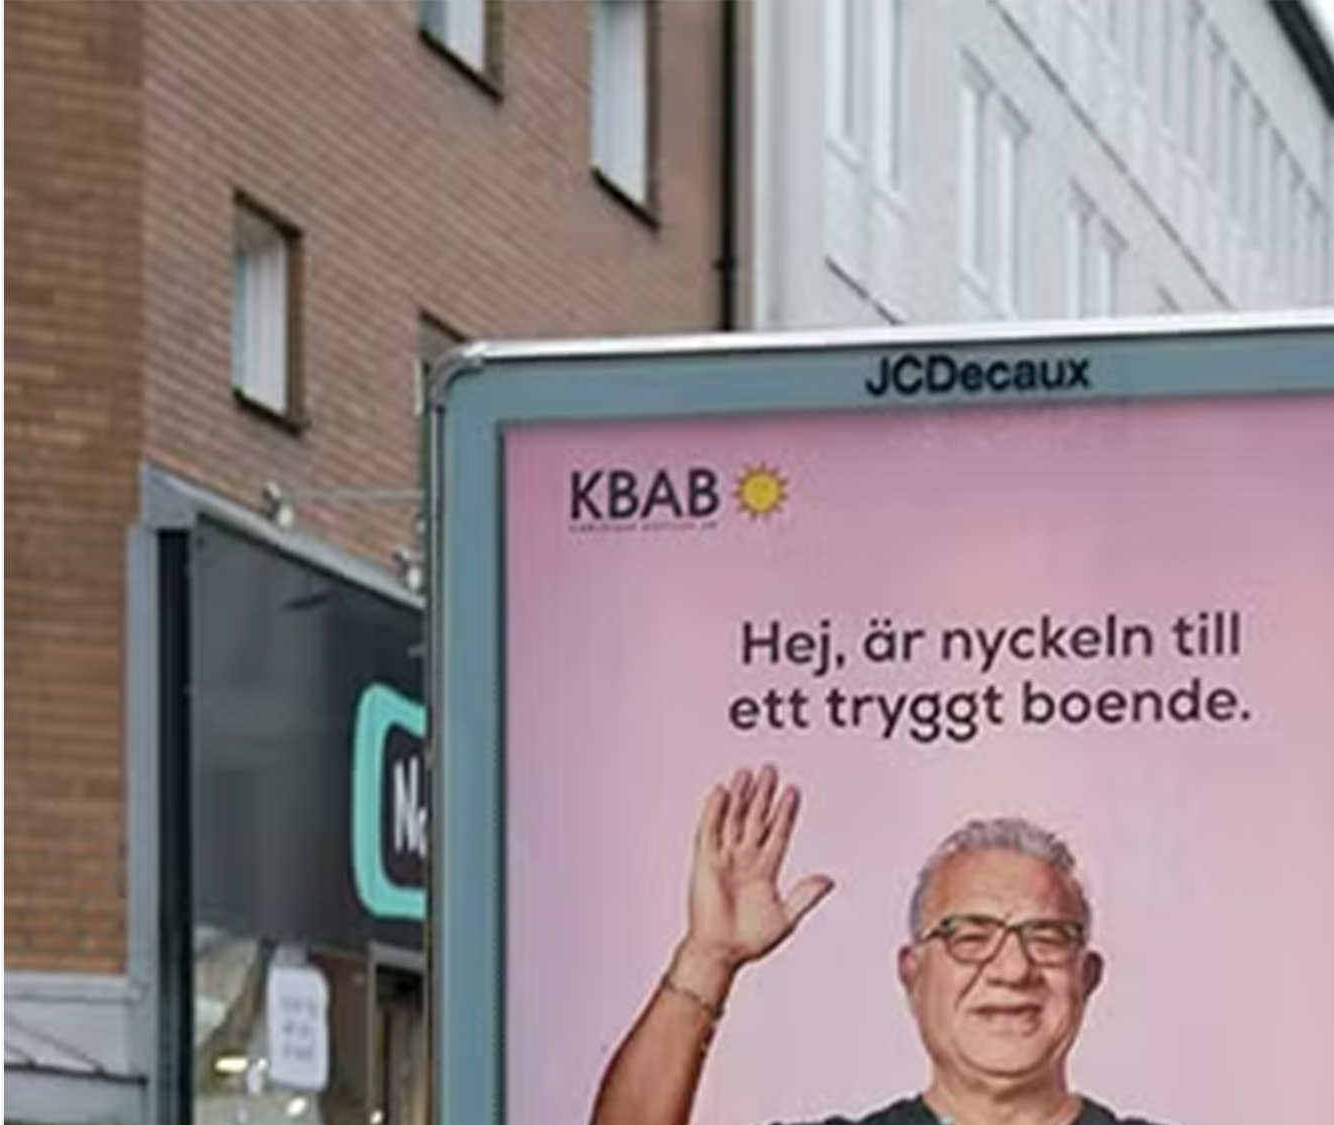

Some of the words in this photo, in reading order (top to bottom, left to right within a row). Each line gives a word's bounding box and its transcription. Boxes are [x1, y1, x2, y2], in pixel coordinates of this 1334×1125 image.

[864, 354, 1090, 397] JCDecaux
[571, 468, 720, 520] KBAB
[741, 620, 847, 677] Hej,
[863, 619, 925, 662] är
[941, 613, 1153, 673] nyckeln
[1172, 611, 1241, 657] till
[729, 687, 810, 730] ett
[826, 684, 1005, 742] tryggt
[1022, 678, 1251, 724] boende.
